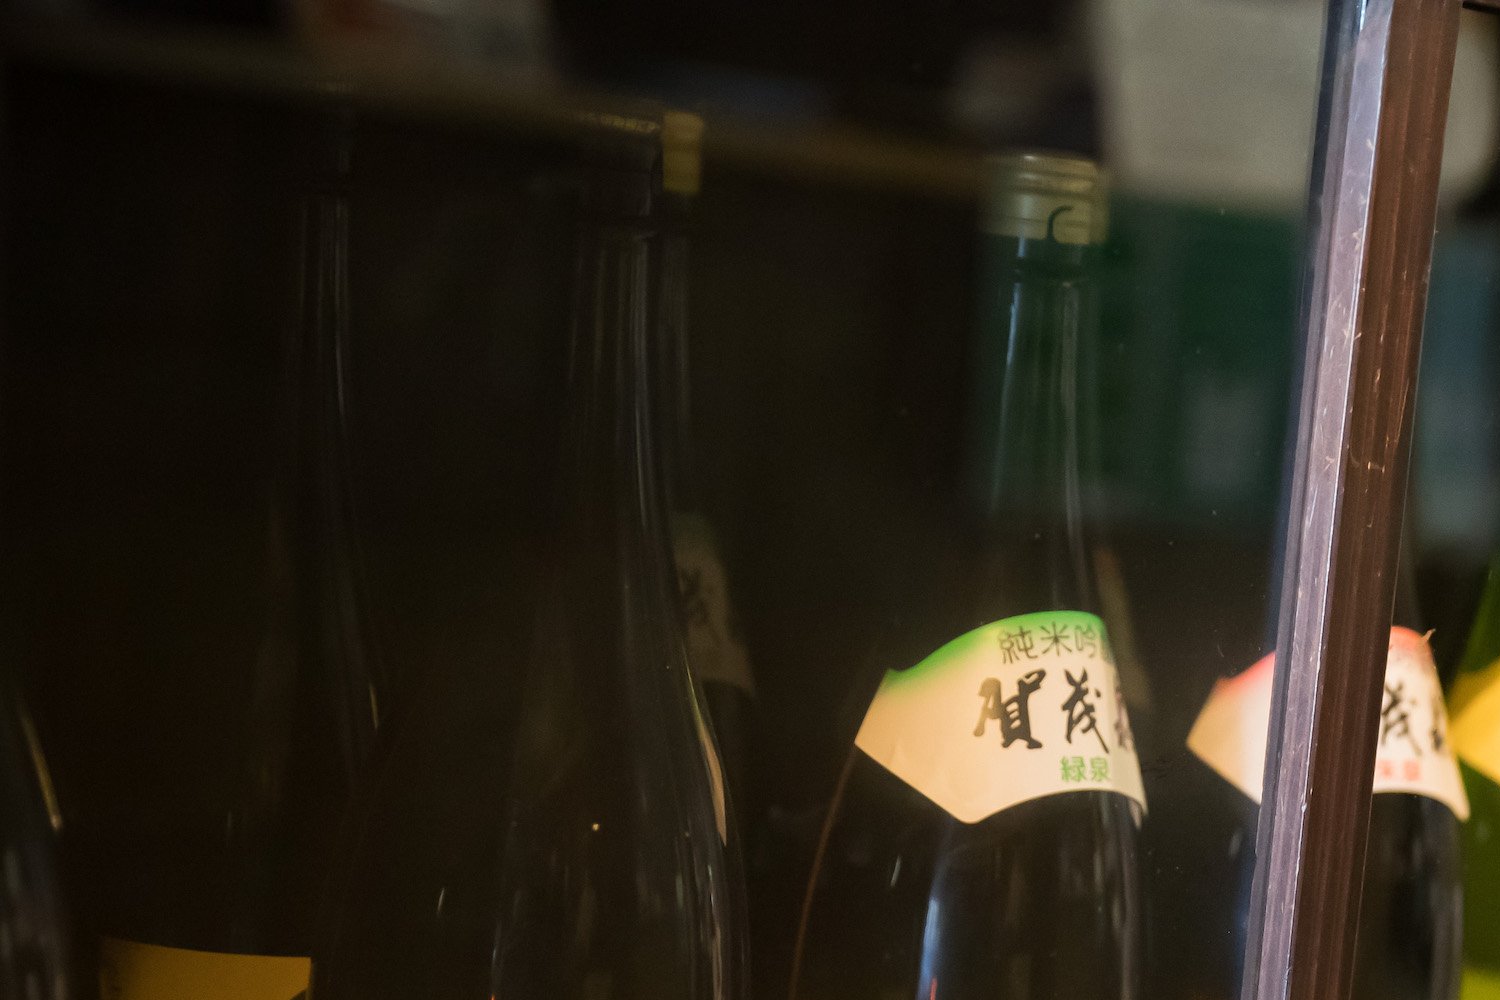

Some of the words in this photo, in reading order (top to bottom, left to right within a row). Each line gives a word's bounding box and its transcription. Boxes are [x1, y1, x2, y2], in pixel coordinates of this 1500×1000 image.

[998, 620, 1109, 665] 純米吟
[1060, 756, 1112, 783] 緑泉
